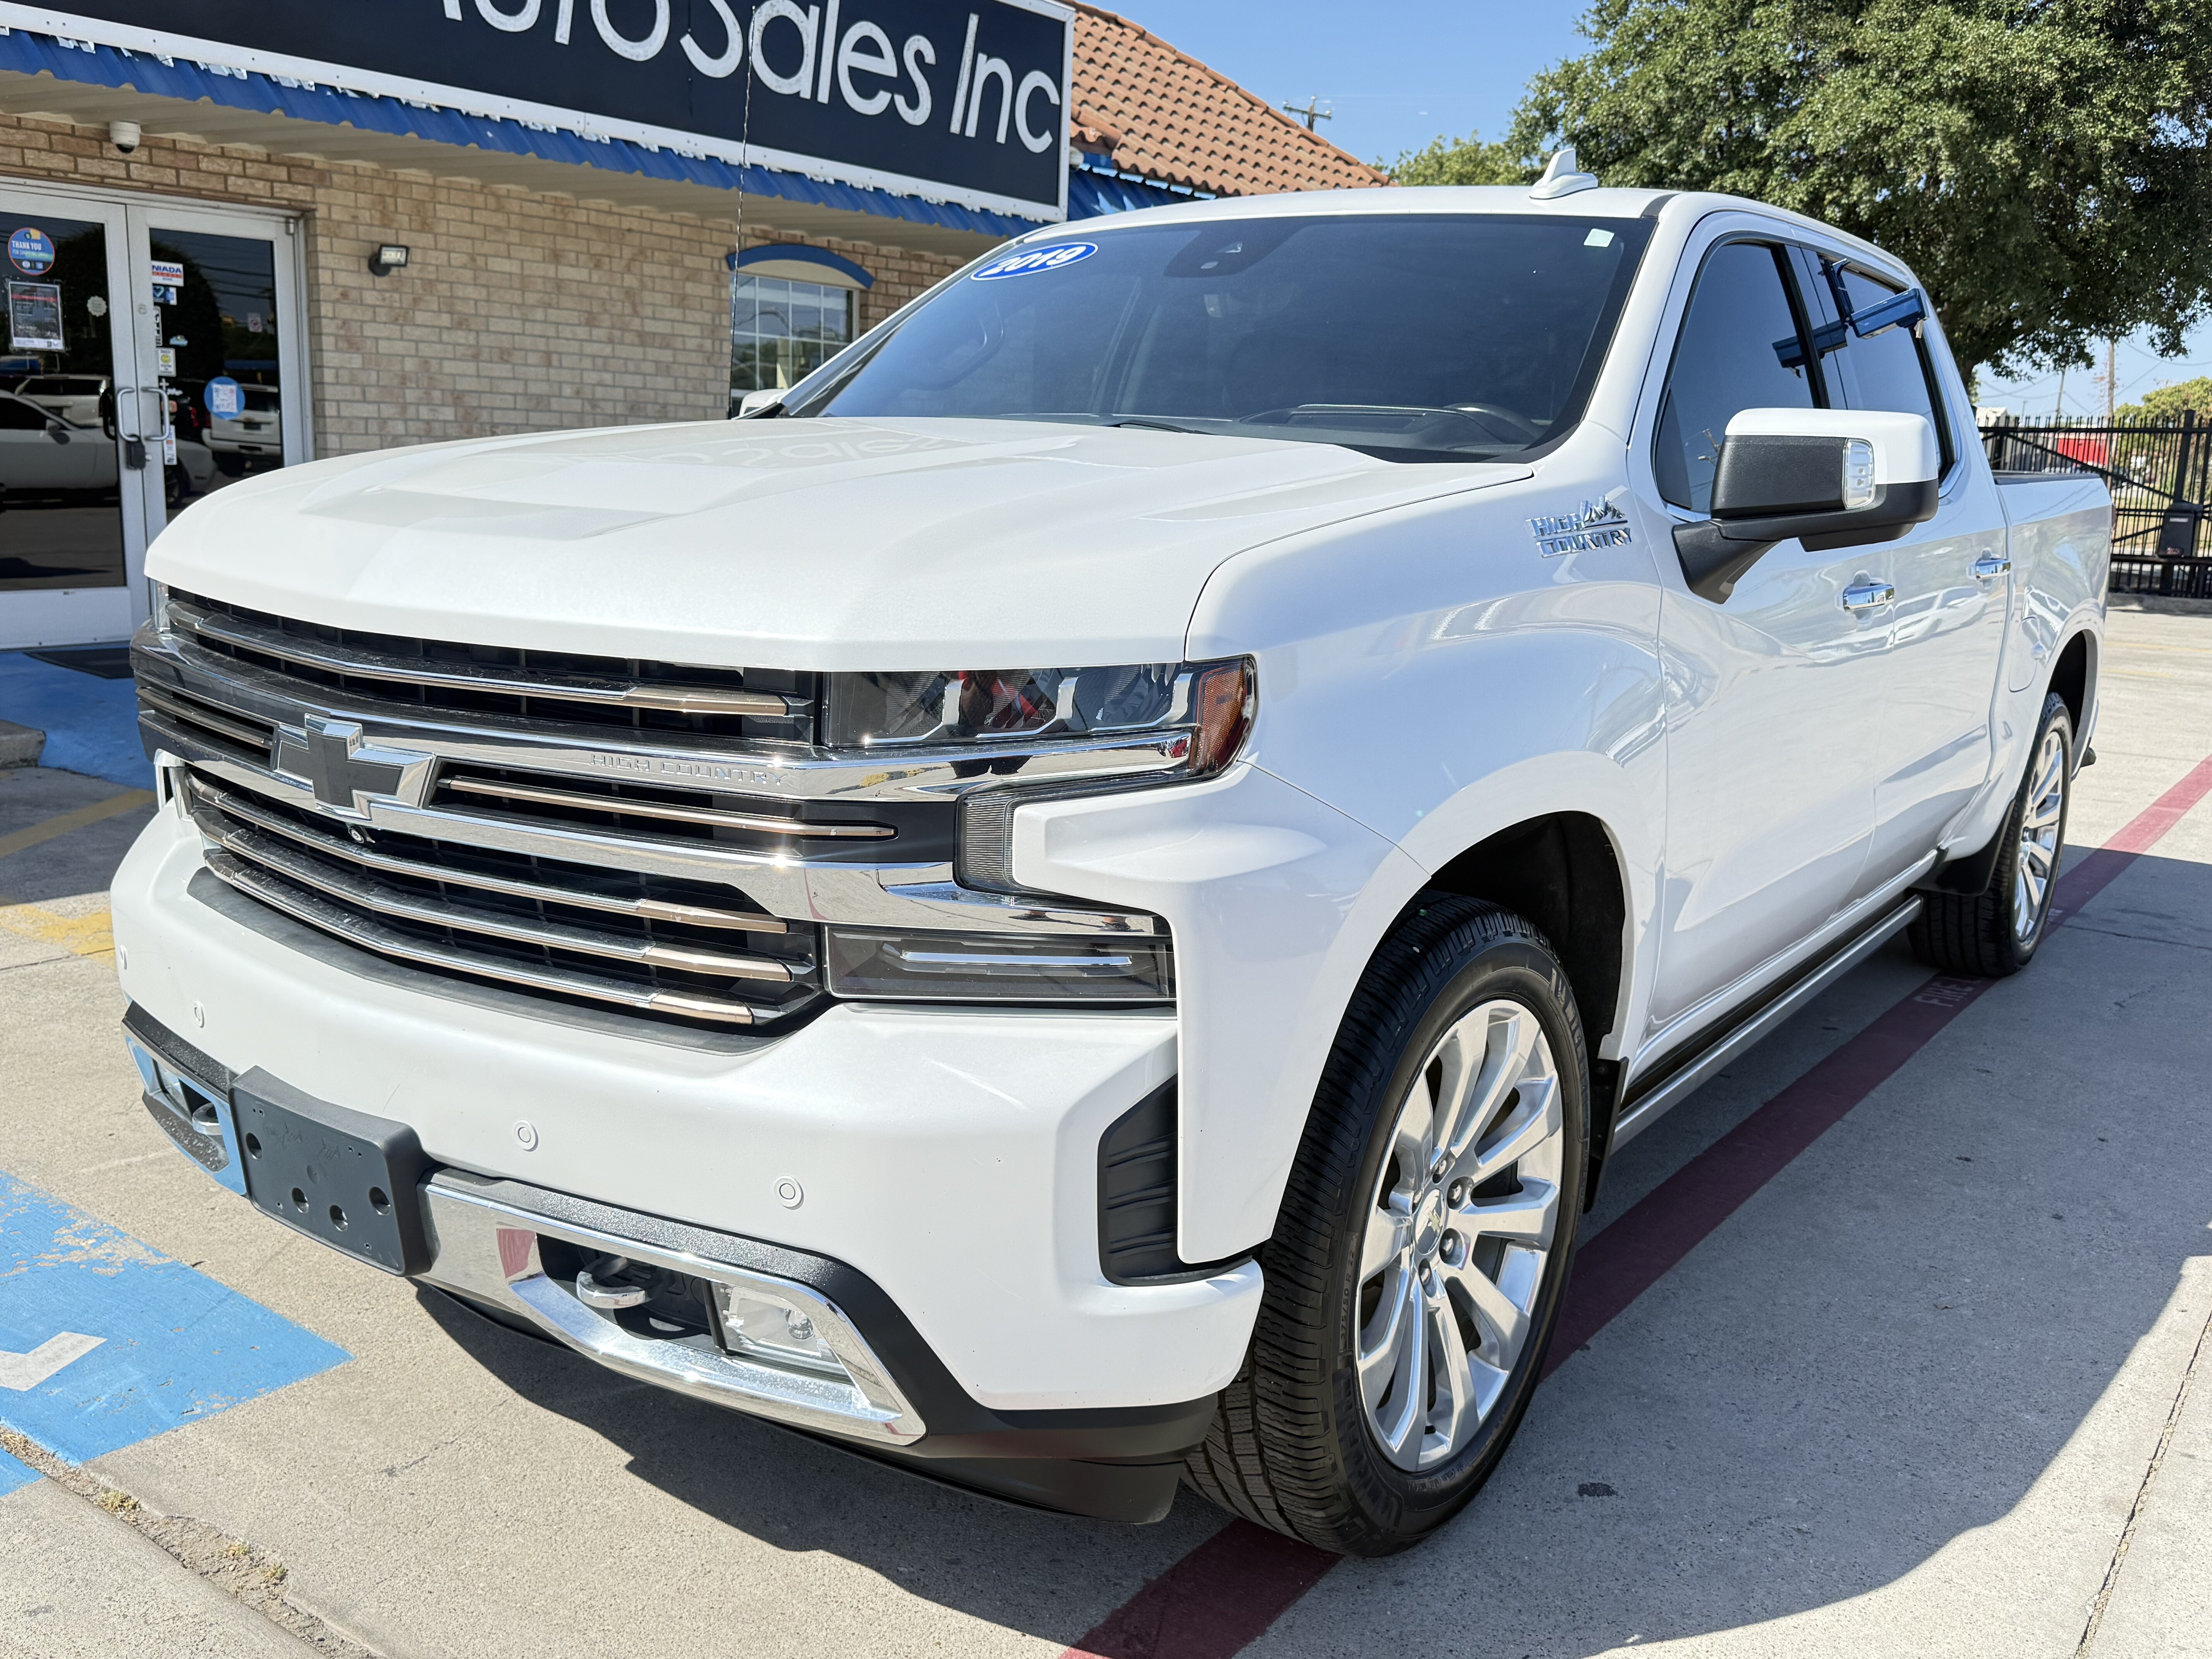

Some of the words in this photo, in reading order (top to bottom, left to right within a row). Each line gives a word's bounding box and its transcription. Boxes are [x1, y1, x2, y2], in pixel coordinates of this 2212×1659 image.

[949, 13, 1060, 153] Inc
[11, 240, 30, 249] THANK
[31, 242, 41, 251] YOU
[152, 265, 182, 274] NIADA
[978, 246, 1086, 277] 2019
[1525, 513, 1585, 538] HIGH
[1536, 527, 1632, 558] COUNTRY
[591, 754, 651, 772] HIGH
[661, 762, 787, 786] COUNTRY
